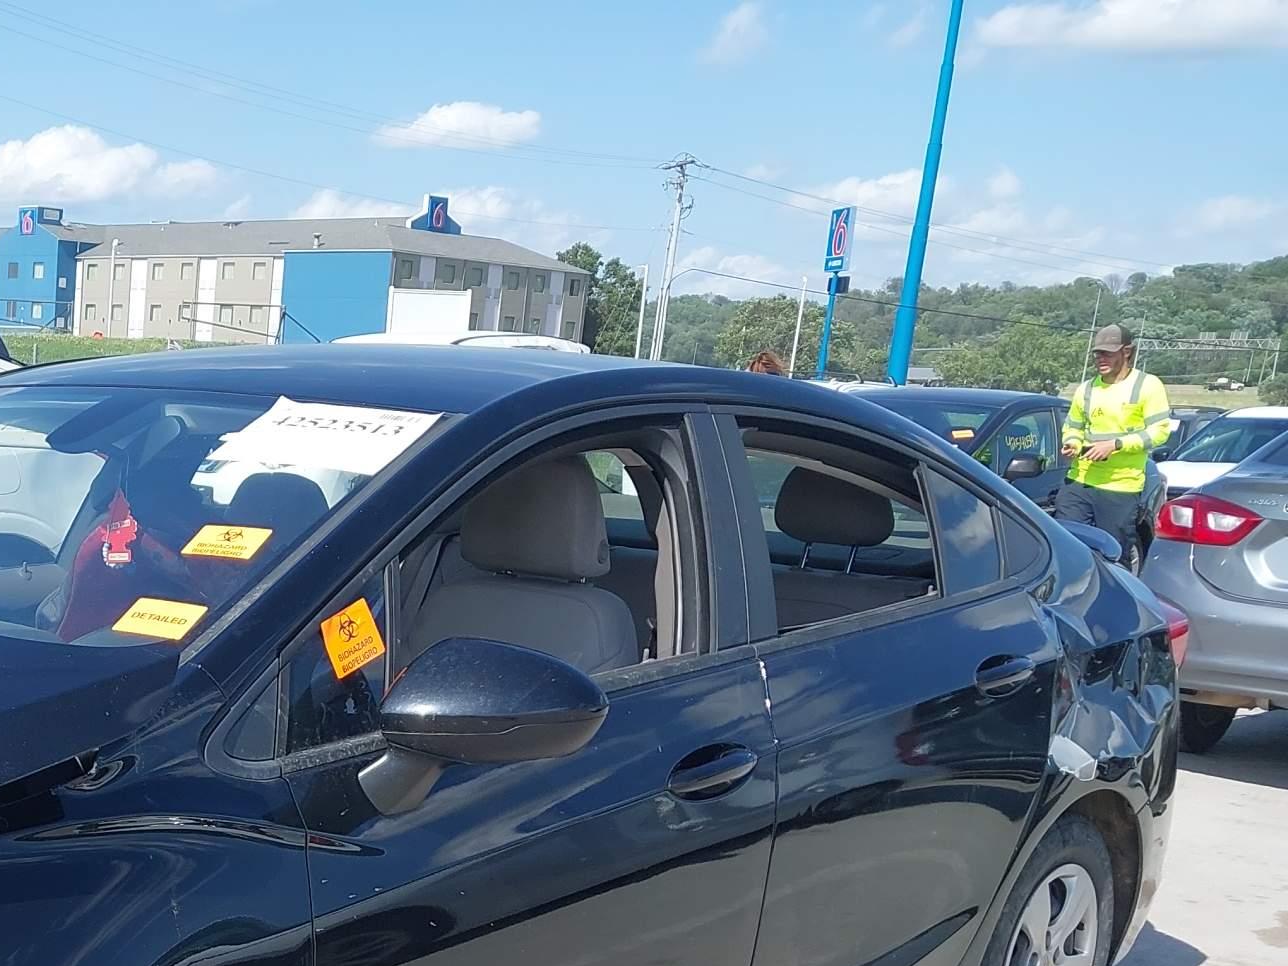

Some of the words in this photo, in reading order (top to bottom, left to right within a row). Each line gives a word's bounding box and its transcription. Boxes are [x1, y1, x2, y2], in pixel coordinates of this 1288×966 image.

[22, 210, 33, 235] 6
[433, 202, 444, 228] 6
[832, 209, 848, 256] 6
[272, 415, 404, 436] 42523513
[130, 611, 188, 625] DETAILED
[337, 635, 374, 662] BIOHAZARD
[342, 646, 378, 673] BIOPELIGRO
